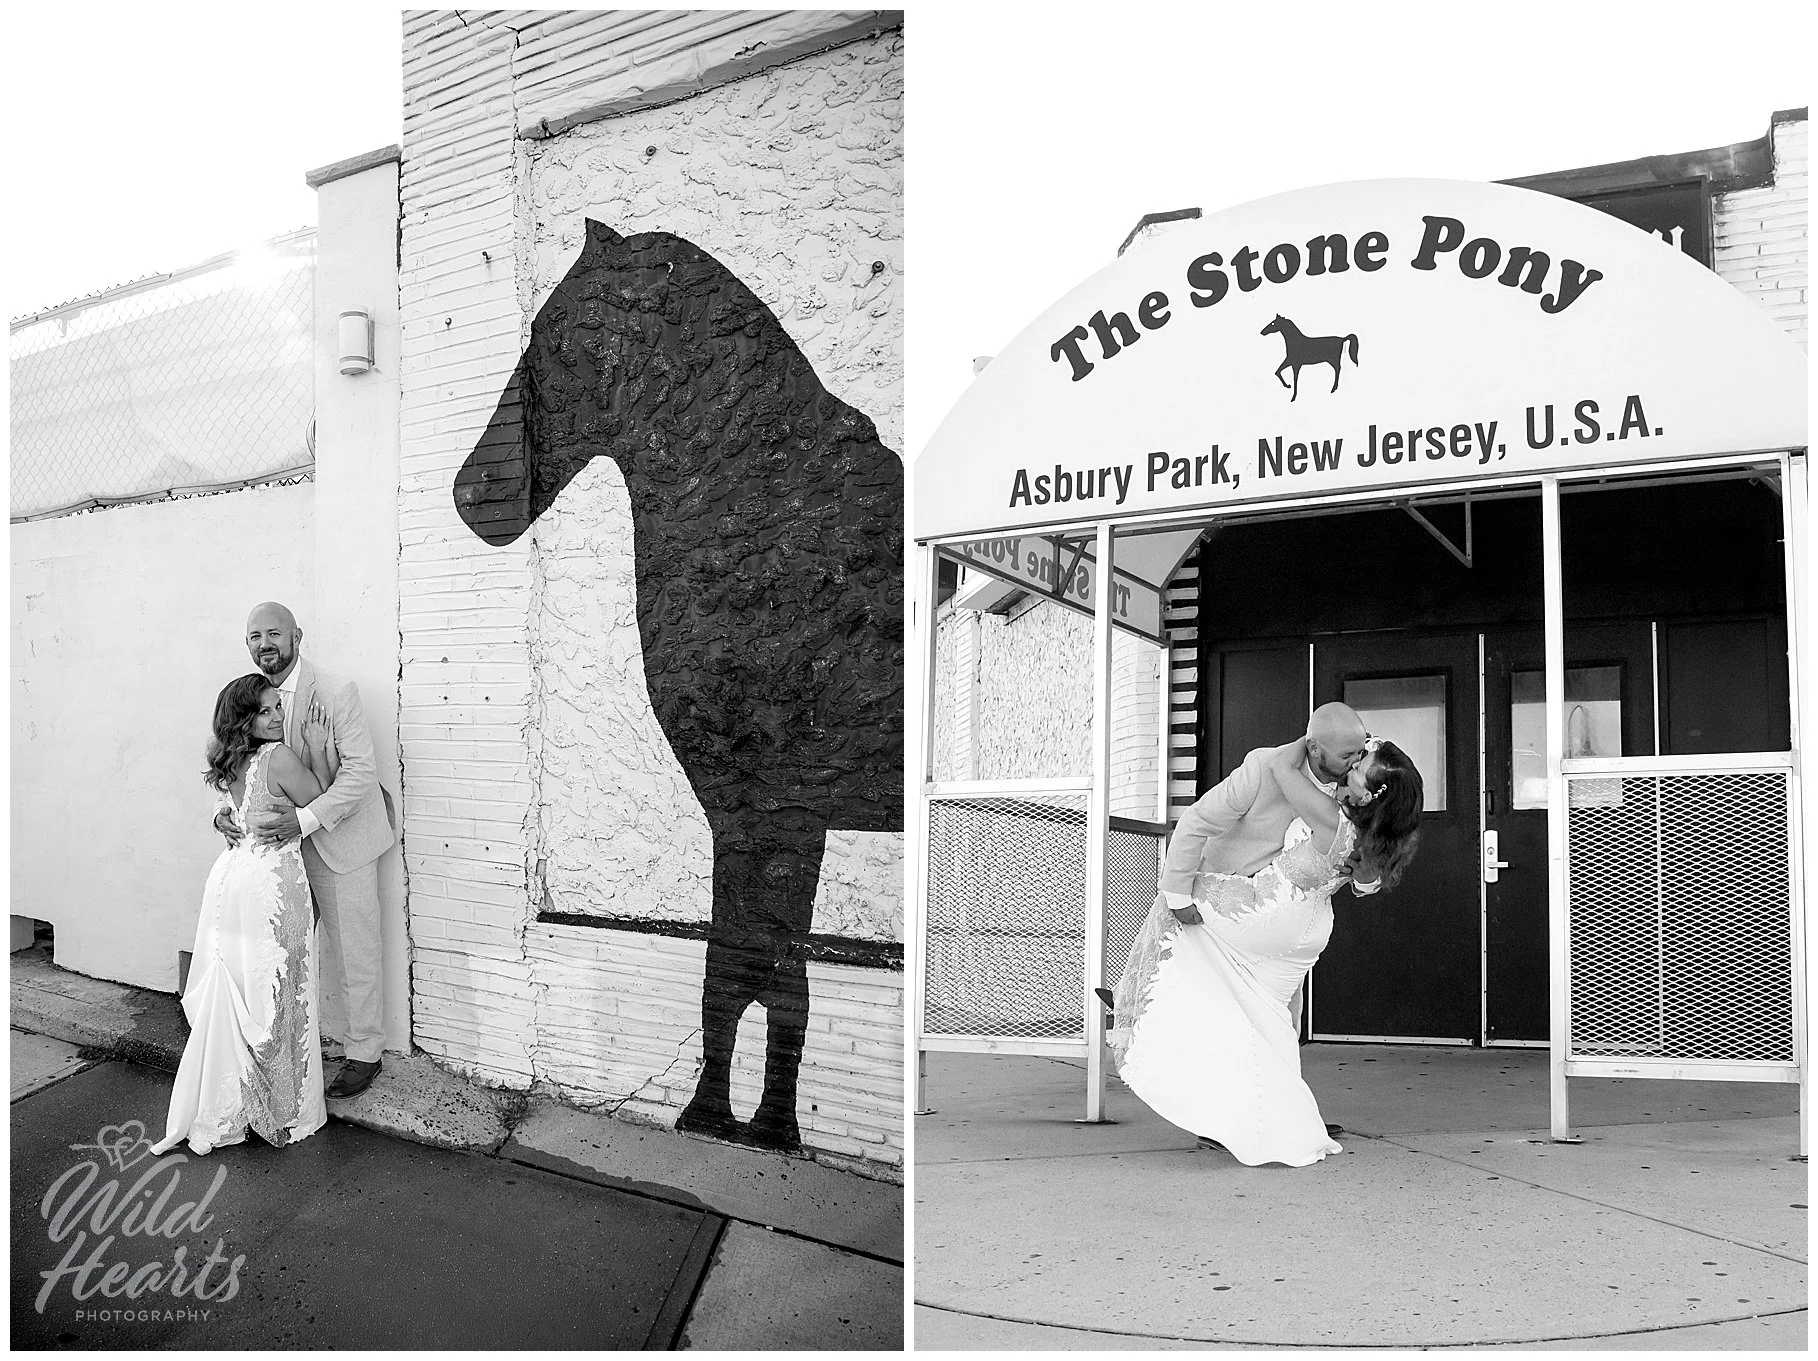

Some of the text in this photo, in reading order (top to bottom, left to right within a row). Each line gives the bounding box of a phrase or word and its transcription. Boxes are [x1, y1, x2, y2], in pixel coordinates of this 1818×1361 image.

[1051, 216, 1604, 382] The Stone Pony
[1009, 395, 1664, 507] Asbury Park, New Jersey, U.S.A.
